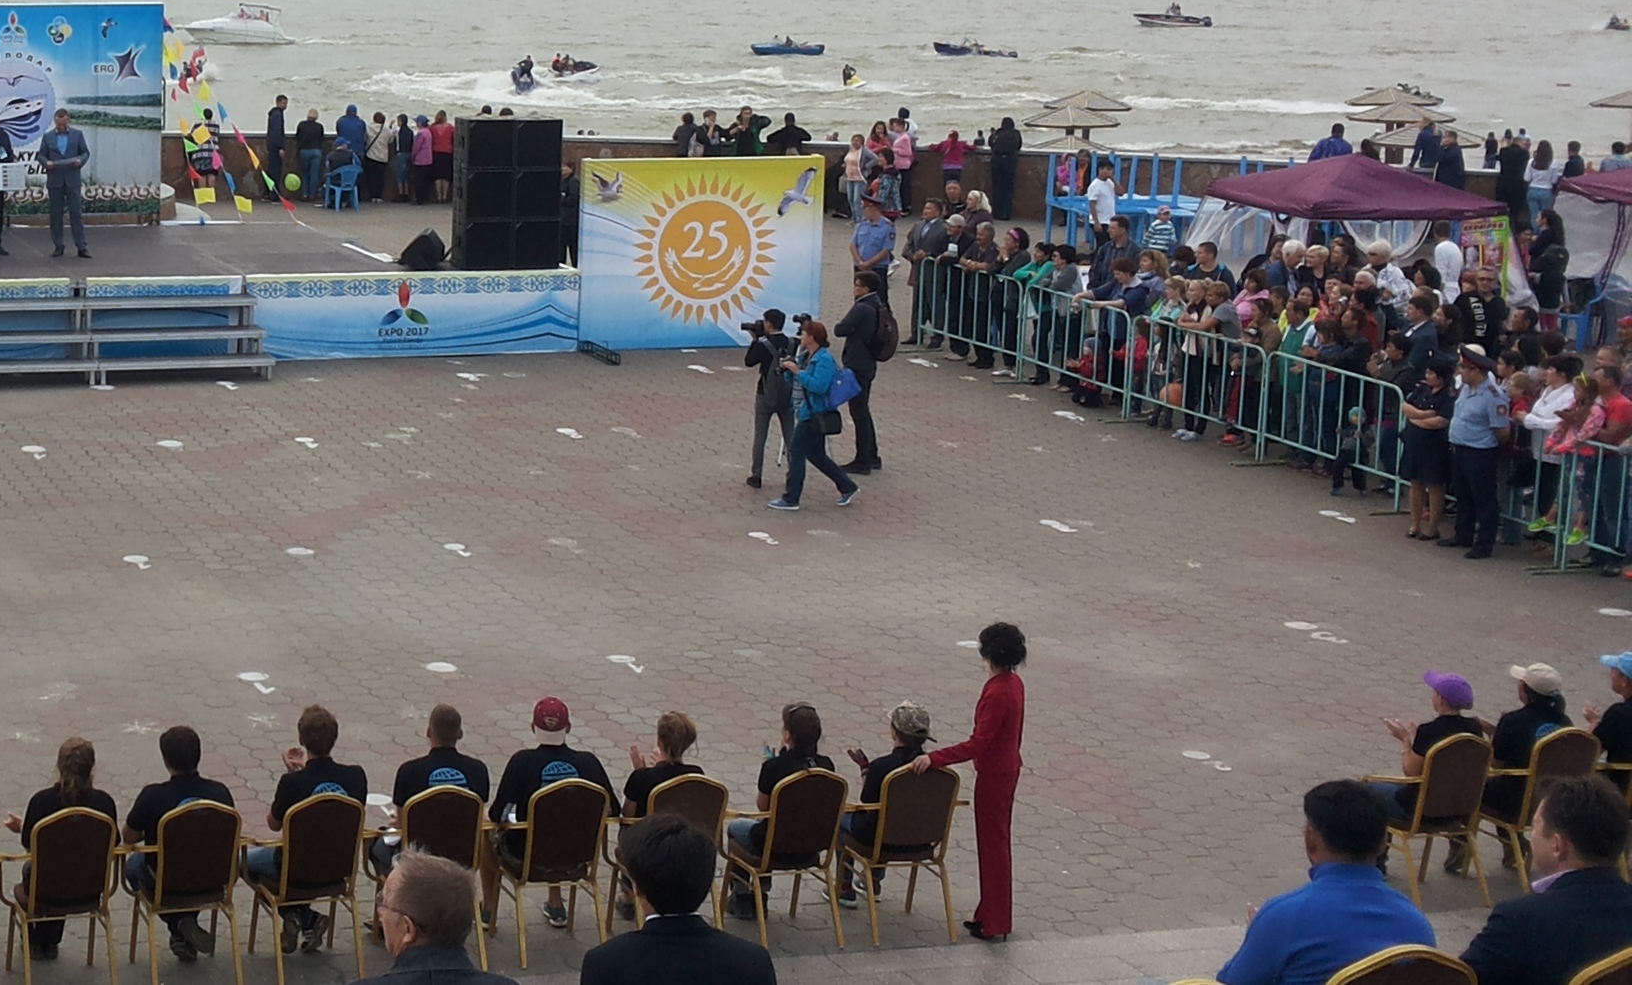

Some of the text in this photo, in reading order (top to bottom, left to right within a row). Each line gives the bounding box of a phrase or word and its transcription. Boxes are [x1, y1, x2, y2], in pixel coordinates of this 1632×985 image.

[93, 64, 115, 74] ERG
[681, 219, 728, 261] 25
[378, 326, 429, 337] EXPO 2017
